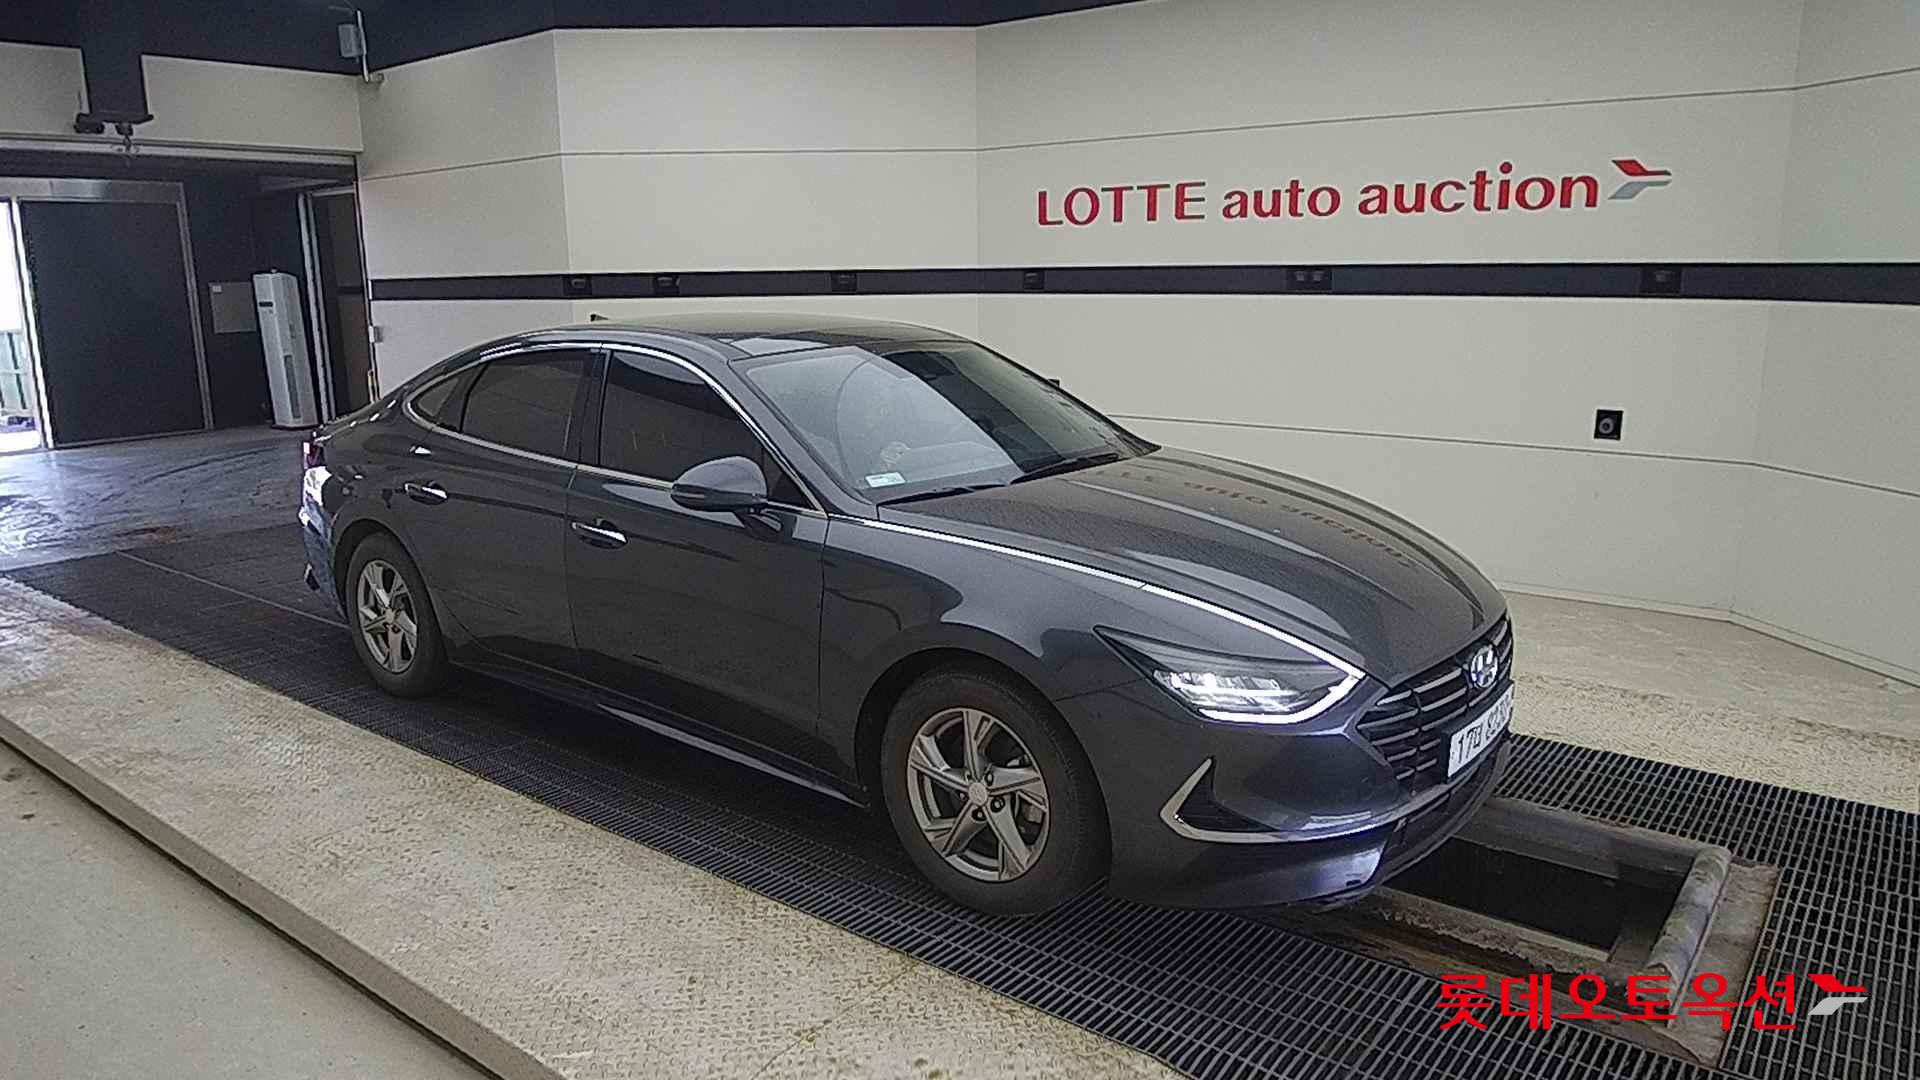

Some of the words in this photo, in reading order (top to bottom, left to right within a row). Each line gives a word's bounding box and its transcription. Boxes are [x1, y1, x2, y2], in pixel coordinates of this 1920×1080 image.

[1038, 182, 1206, 226] LOTTE
[1223, 180, 1341, 220] auto
[1359, 161, 1598, 215] auction
